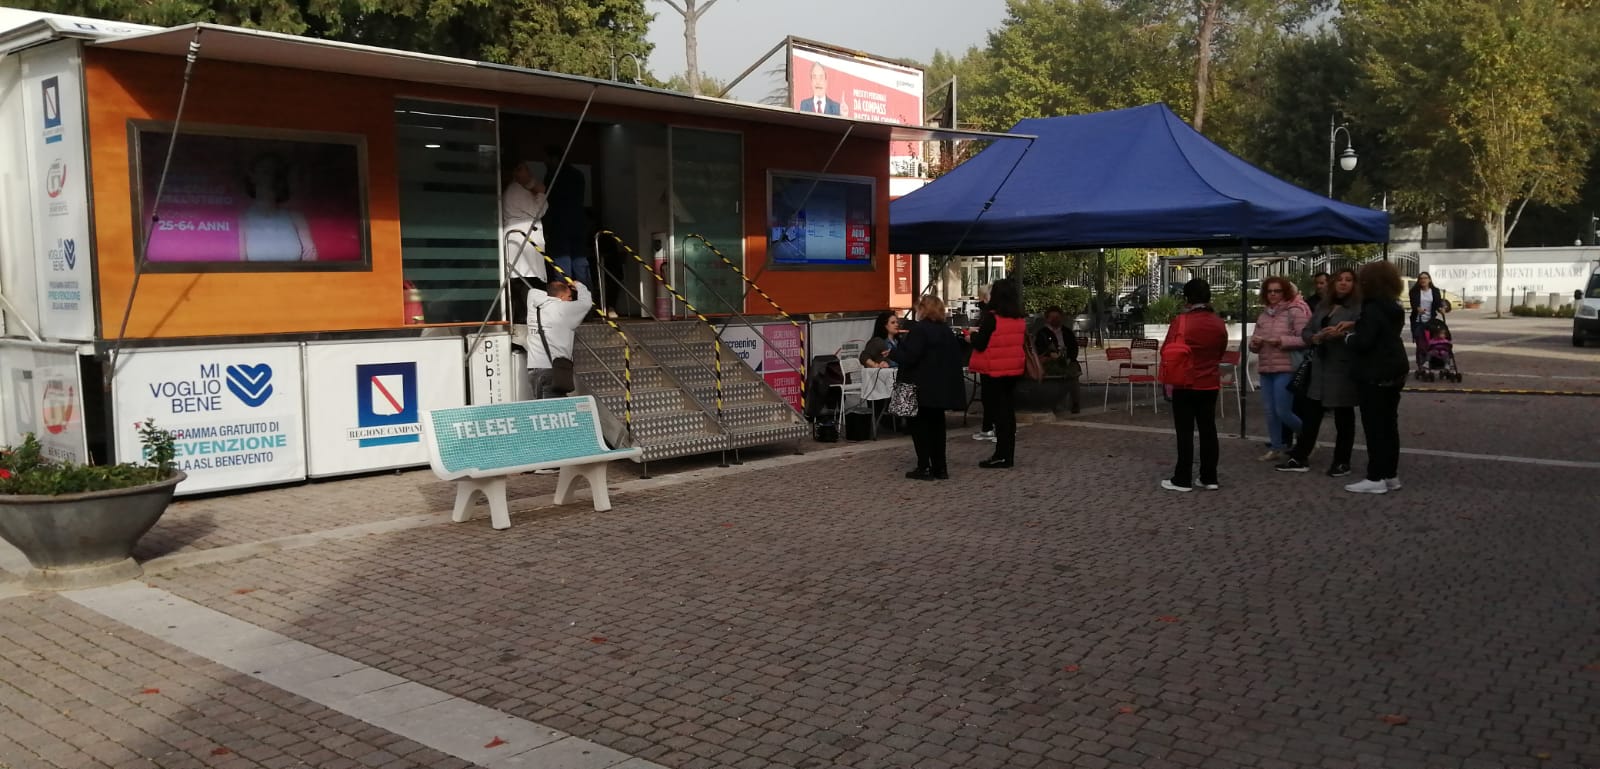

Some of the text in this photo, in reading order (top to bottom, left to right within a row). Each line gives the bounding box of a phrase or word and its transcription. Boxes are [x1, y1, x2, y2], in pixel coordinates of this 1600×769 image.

[853, 98, 887, 115] DA COMPASS
[158, 220, 230, 231] 25-64 ANNI
[1435, 268, 1468, 280] GRANDI
[1538, 267, 1583, 278] BALNEARI
[200, 363, 220, 379] MI
[149, 380, 221, 398] VOGLIO
[172, 396, 222, 413] BENE
[219, 423, 267, 437] GRATUITO
[270, 421, 279, 433] DI
[350, 422, 424, 439] REGIONE CAMPANI
[452, 411, 579, 440] TELESE TERME
[194, 456, 212, 470] ASL
[215, 452, 273, 467] BENEVENTO
